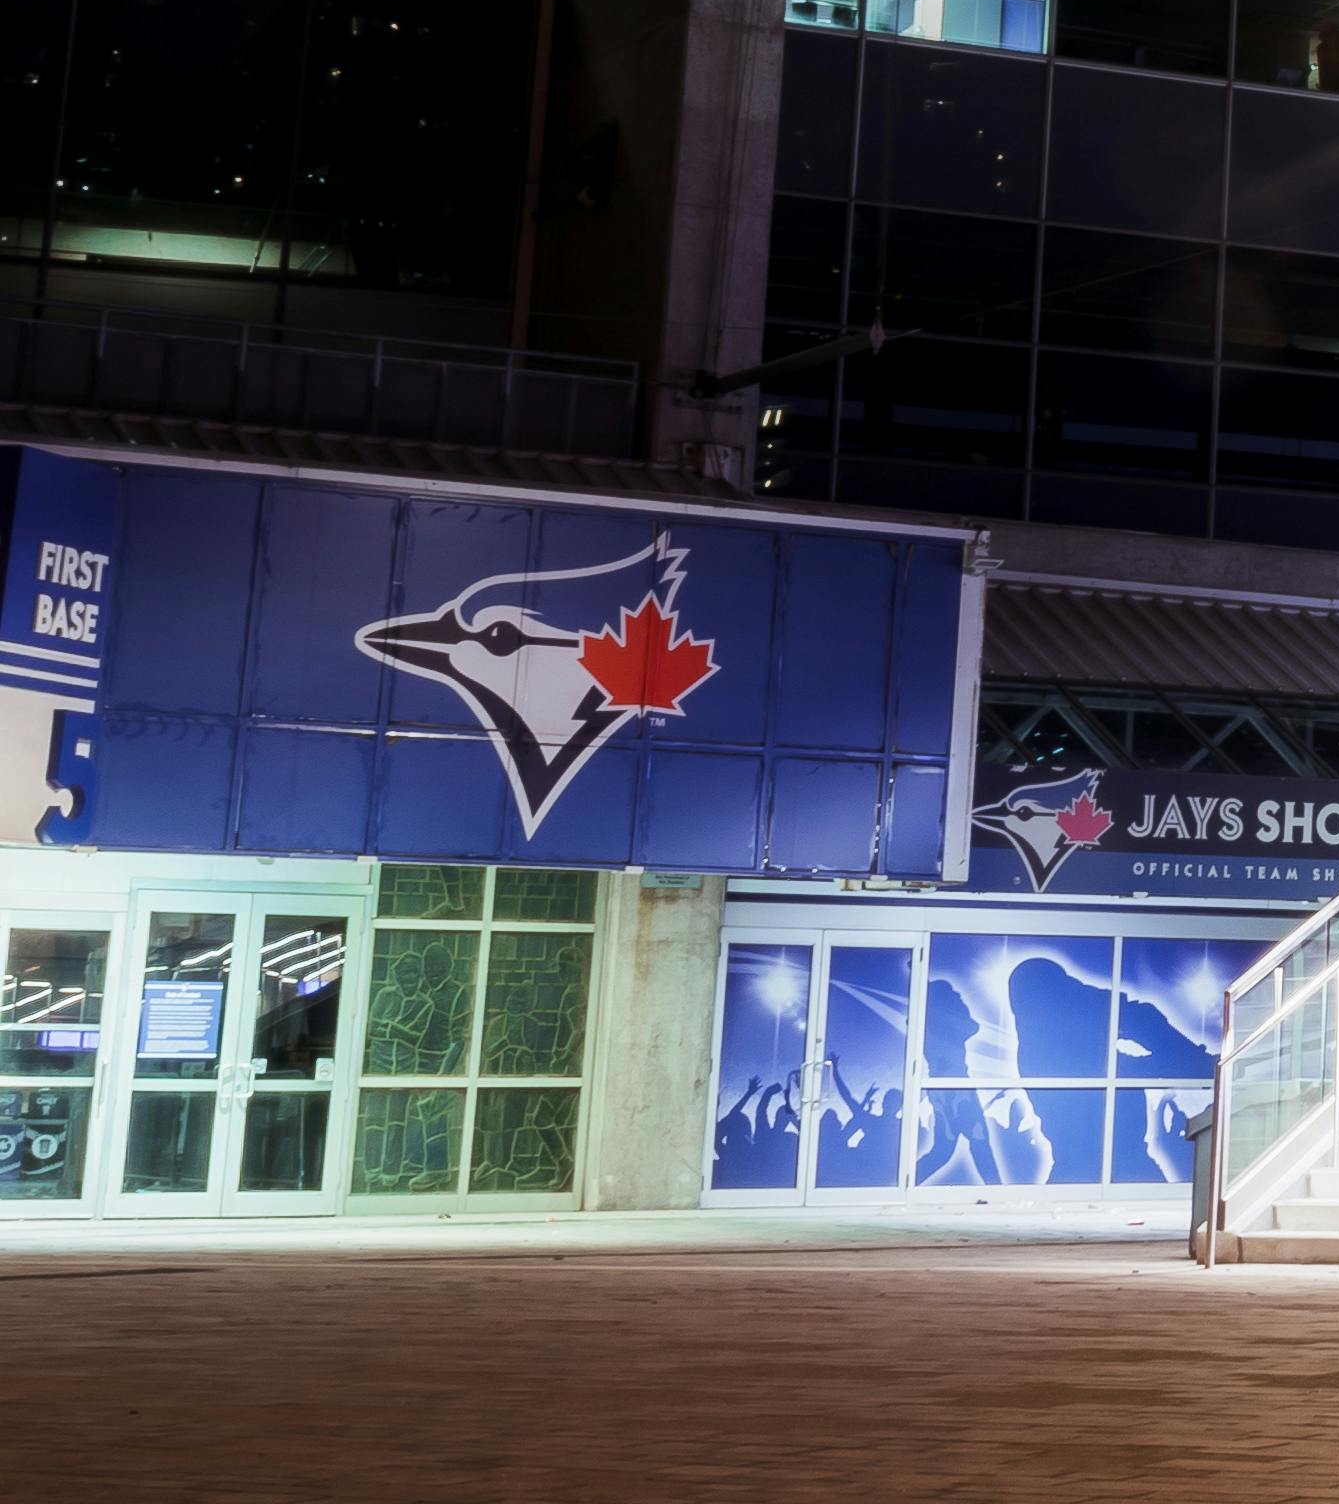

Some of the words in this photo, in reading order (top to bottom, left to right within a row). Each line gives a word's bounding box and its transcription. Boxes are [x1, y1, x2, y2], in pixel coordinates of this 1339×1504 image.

[38, 541, 110, 592] FIRST
[34, 593, 100, 644] BASE
[1127, 794, 1244, 841] JAYS
[1132, 862, 1231, 879] OFFICIAL
[1245, 865, 1298, 881] TEAM
